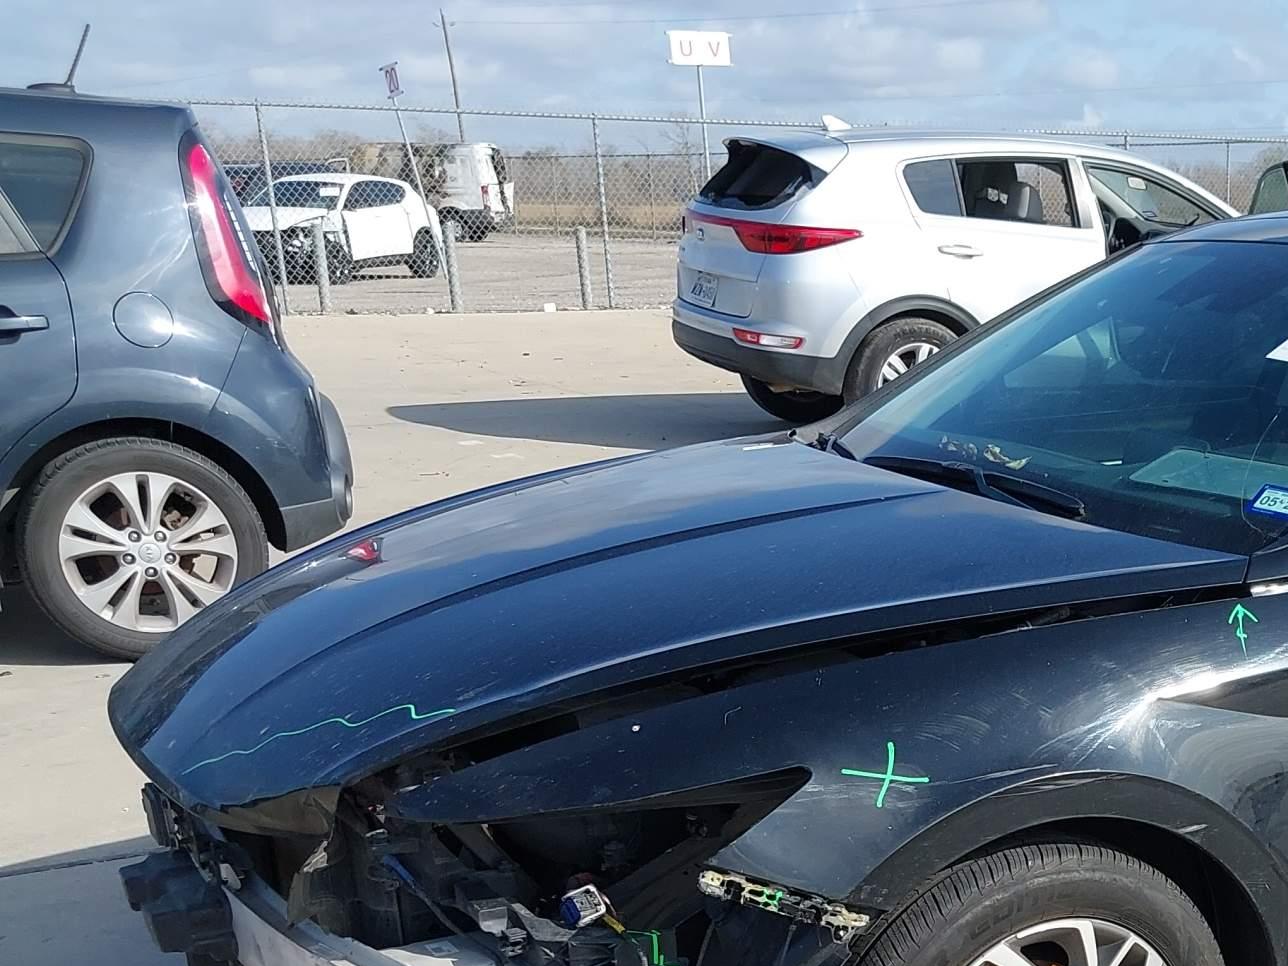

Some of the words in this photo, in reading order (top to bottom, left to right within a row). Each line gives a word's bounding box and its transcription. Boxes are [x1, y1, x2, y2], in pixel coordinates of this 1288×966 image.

[679, 39, 692, 57] U
[708, 40, 720, 57] V
[384, 67, 400, 94] 20
[1258, 495, 1281, 507] 05
